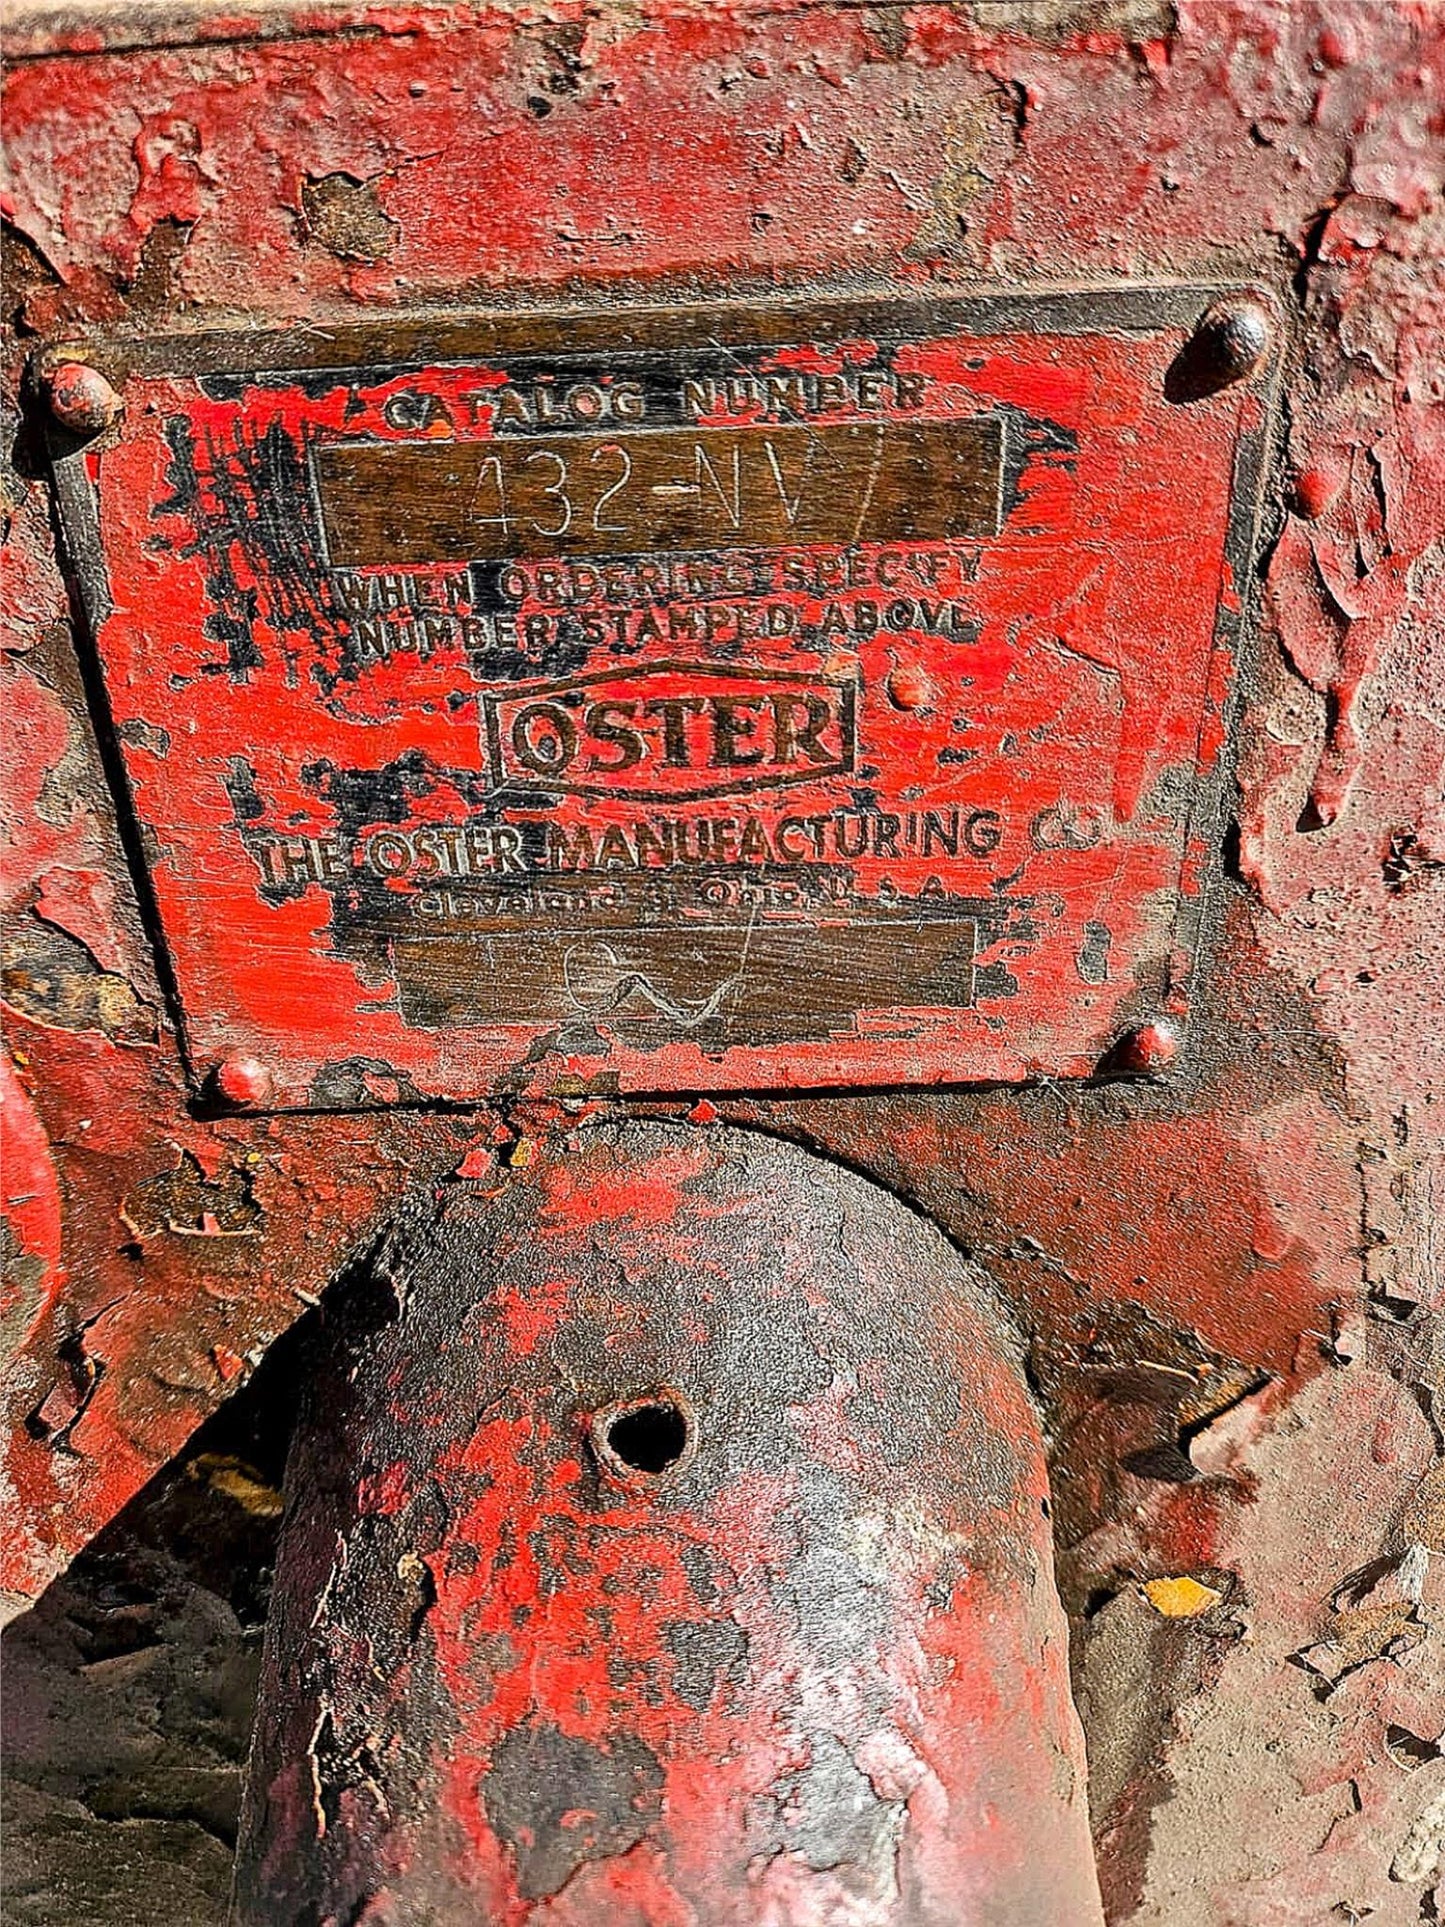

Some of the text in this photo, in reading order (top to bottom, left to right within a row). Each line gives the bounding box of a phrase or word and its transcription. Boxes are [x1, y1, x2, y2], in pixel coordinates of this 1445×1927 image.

[384, 370, 925, 431] CATALOG NUMBER
[333, 566, 474, 615] WHEN
[355, 597, 978, 658] NUMBER STAMPED ABOVE
[511, 693, 834, 775] OSTER
[247, 834, 349, 886] THE
[366, 824, 530, 879] OSTER
[546, 806, 1001, 872] MANUFACTURING
